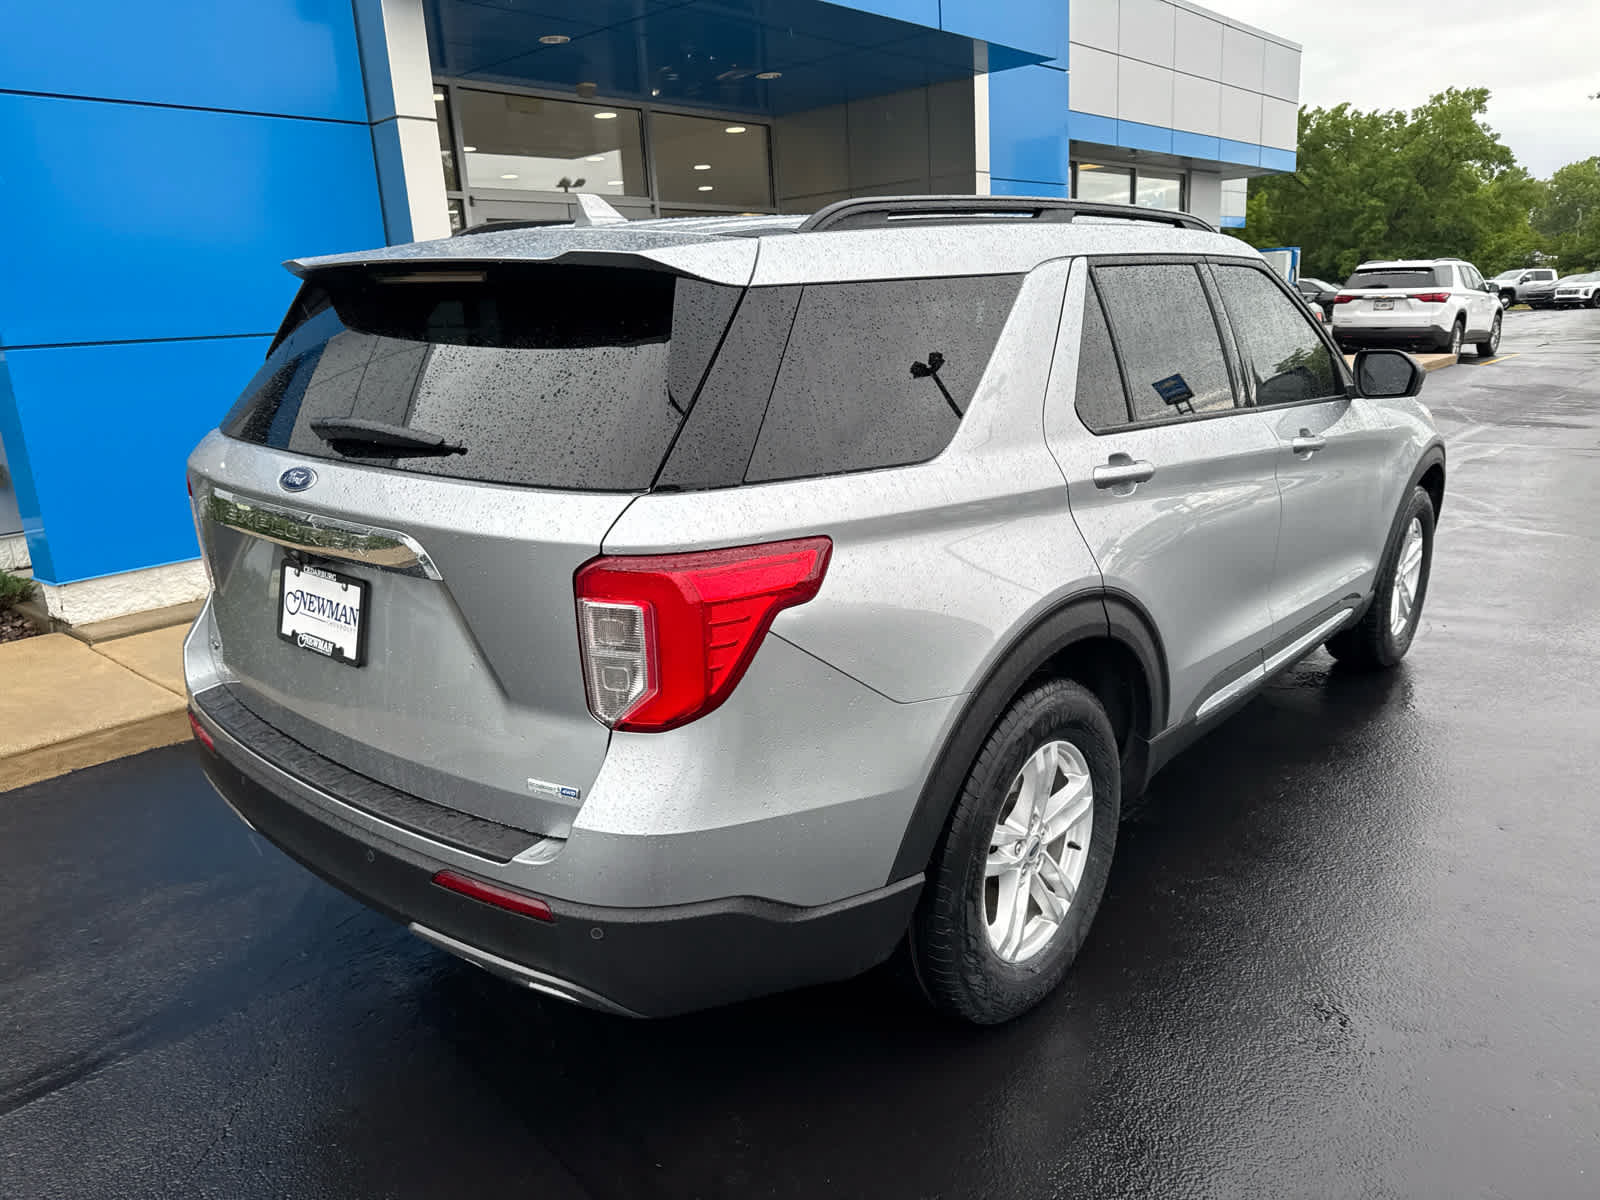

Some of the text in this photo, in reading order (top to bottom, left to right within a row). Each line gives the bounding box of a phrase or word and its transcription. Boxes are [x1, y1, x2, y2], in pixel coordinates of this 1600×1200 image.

[226, 508, 368, 557] EXPLORER
[286, 589, 359, 627] NEWMAN
[297, 633, 333, 655] NEWMAN
